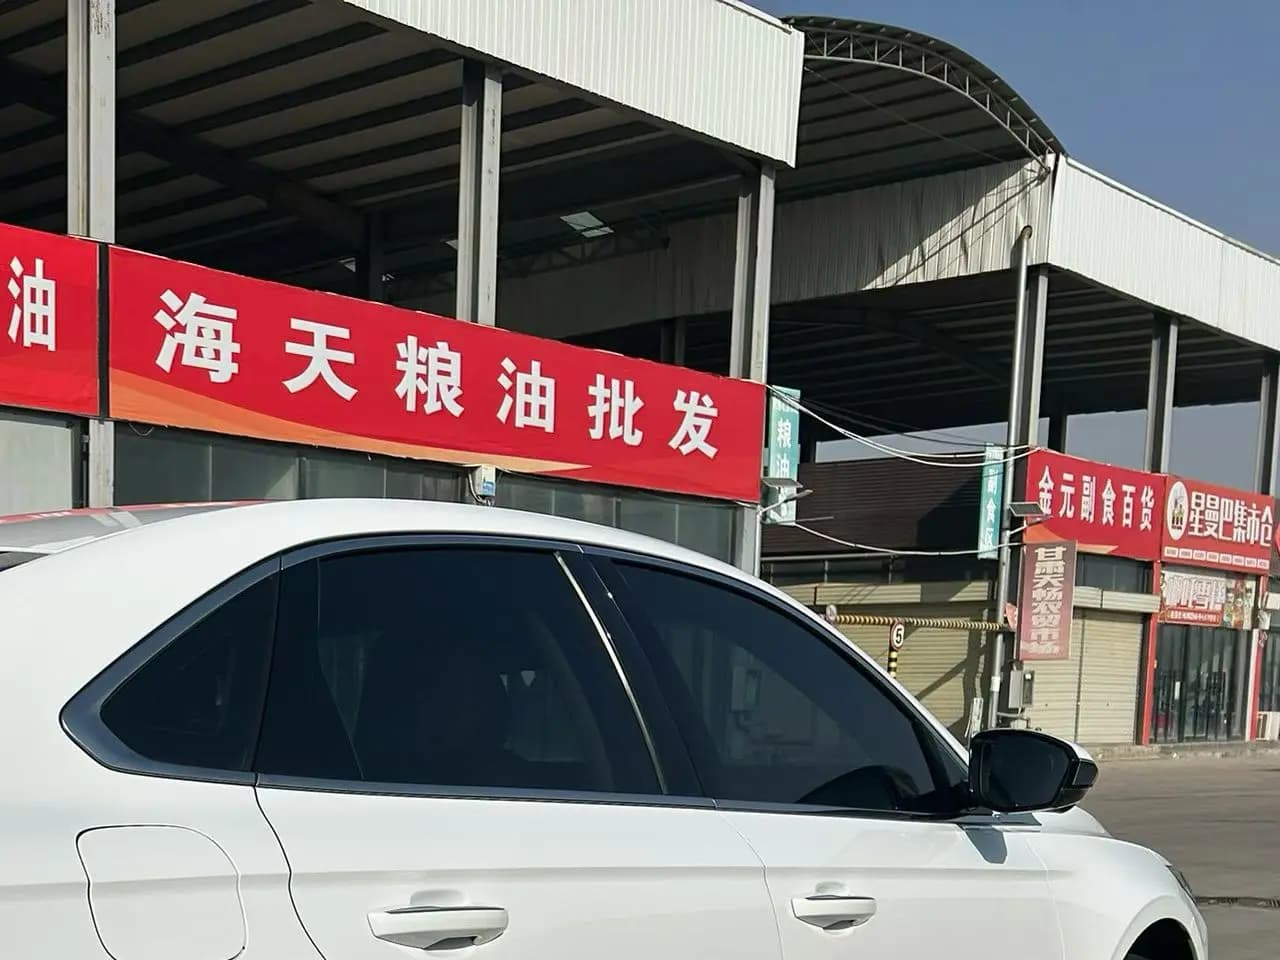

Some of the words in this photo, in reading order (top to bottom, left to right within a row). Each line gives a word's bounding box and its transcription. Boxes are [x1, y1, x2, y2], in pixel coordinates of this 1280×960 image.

[153, 288, 719, 458] 海天粮油批发
[1038, 464, 1155, 532] 金元副食百货
[895, 628, 905, 644] 5
